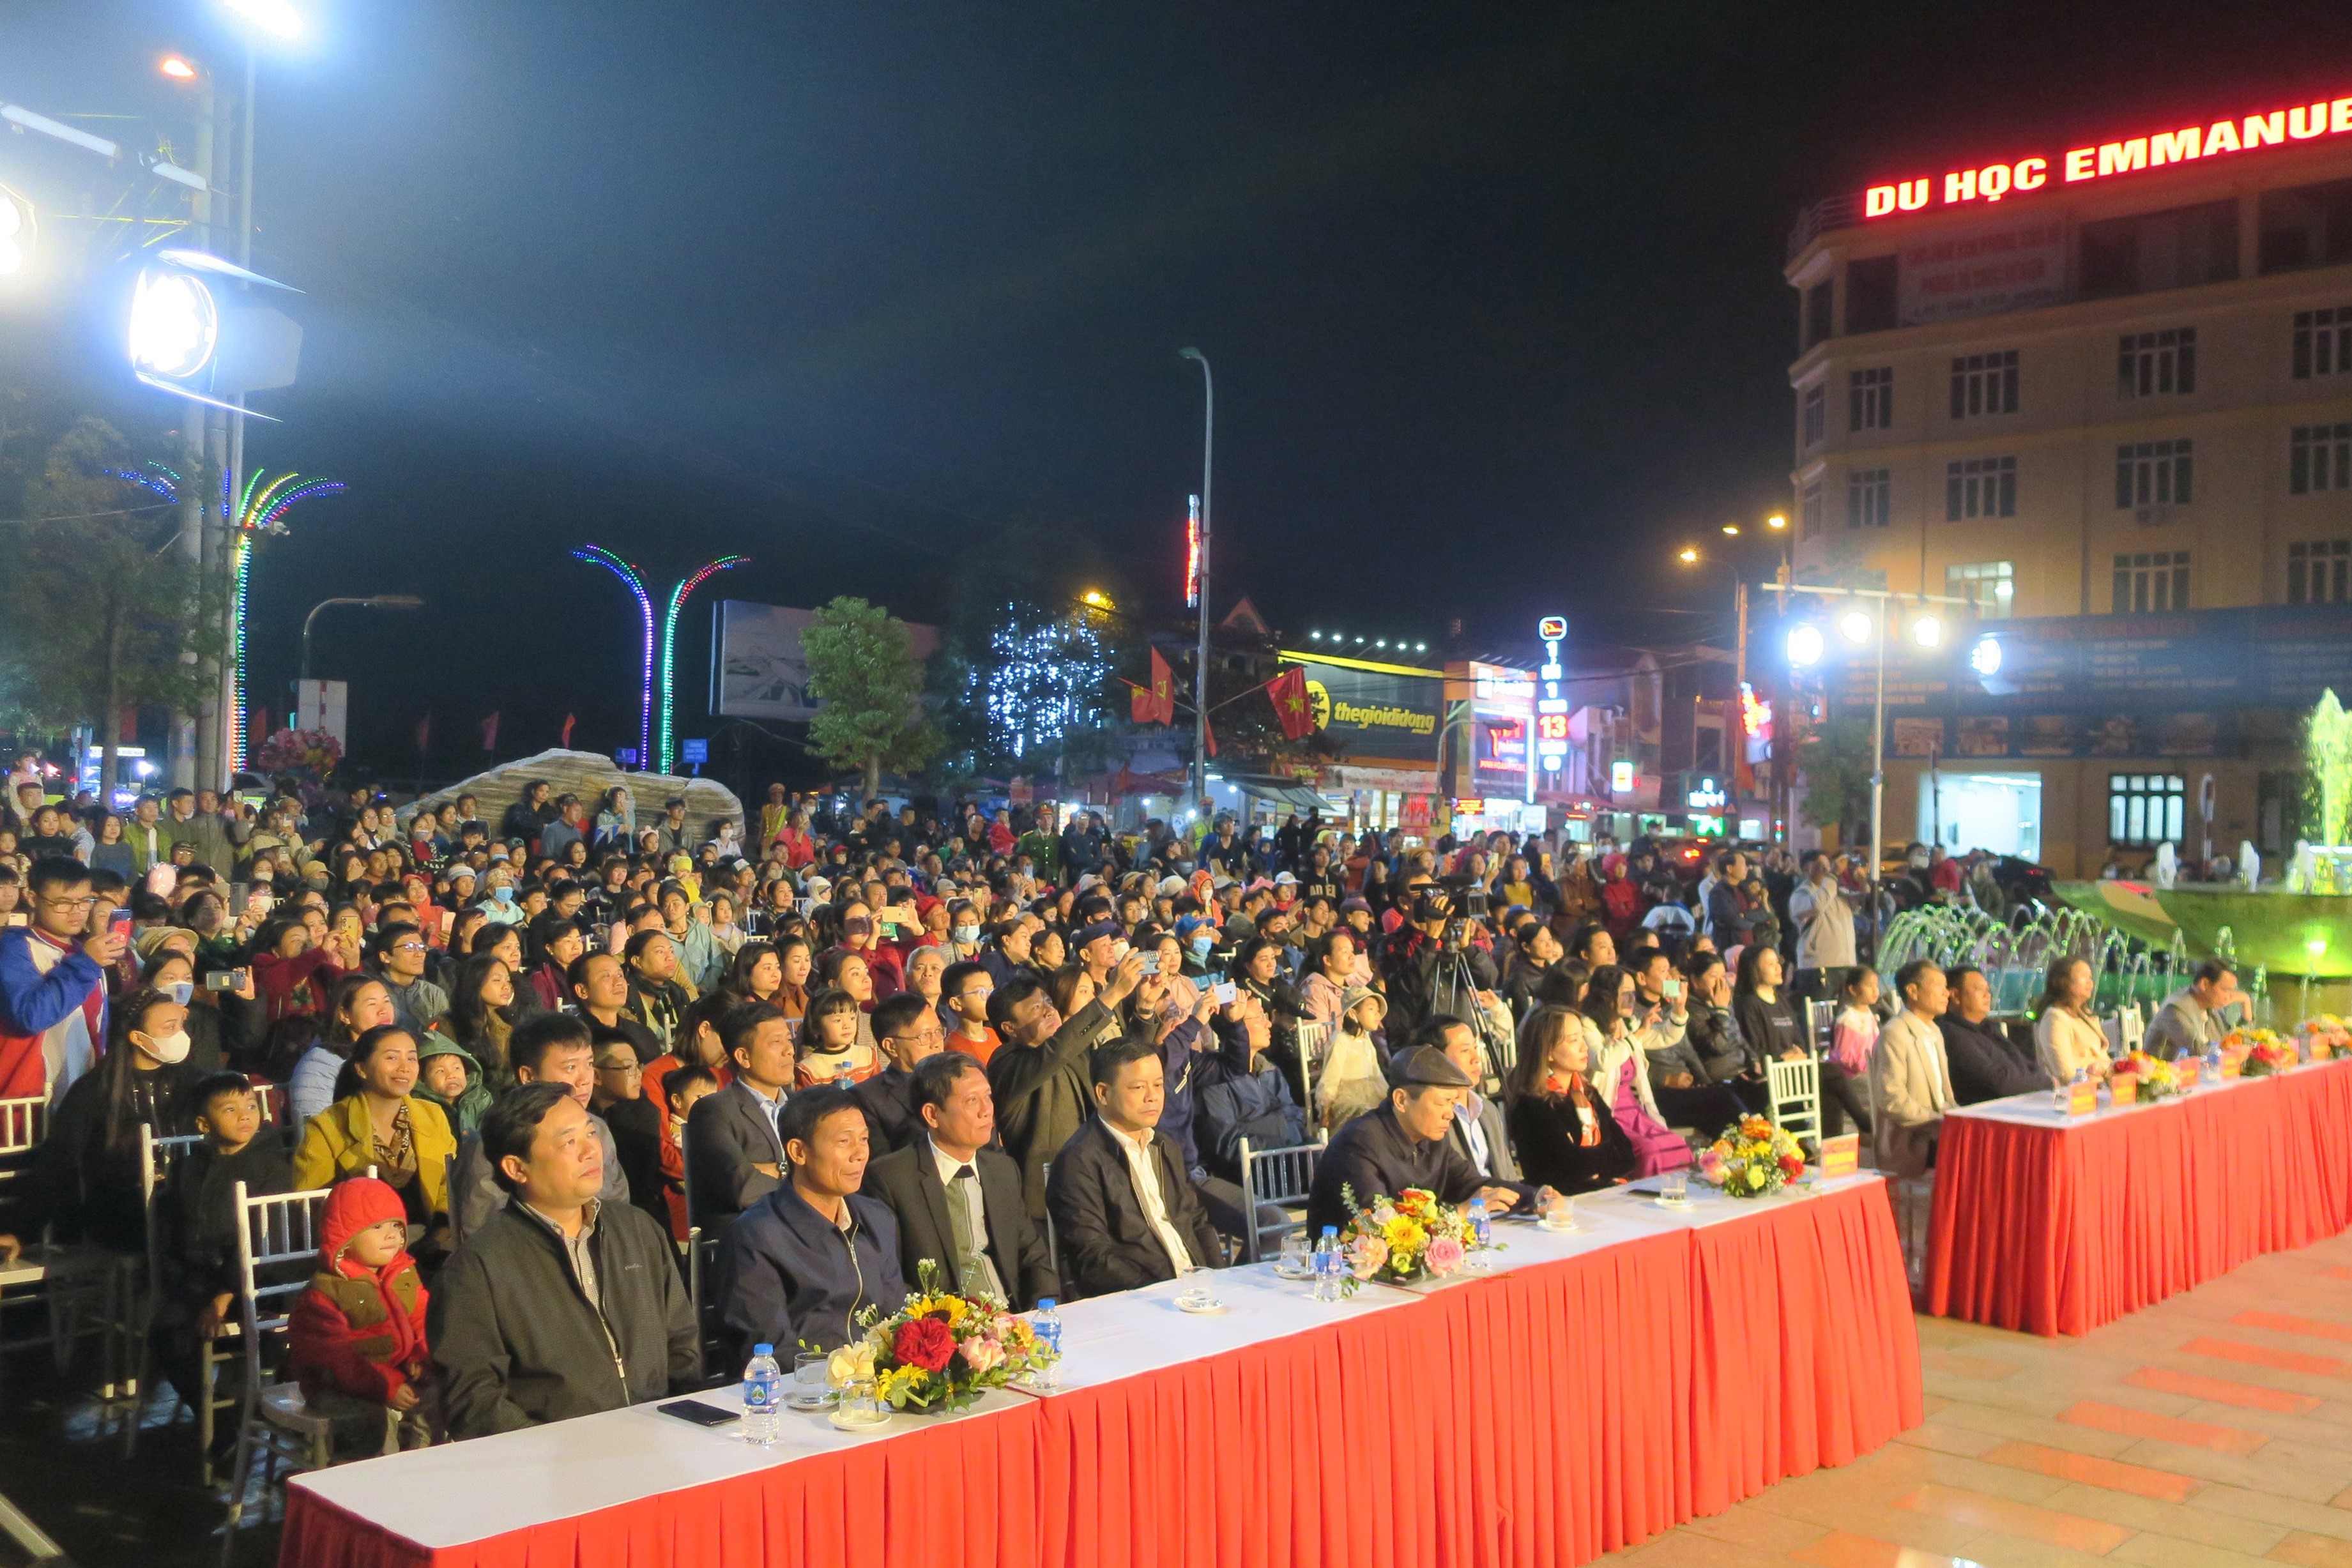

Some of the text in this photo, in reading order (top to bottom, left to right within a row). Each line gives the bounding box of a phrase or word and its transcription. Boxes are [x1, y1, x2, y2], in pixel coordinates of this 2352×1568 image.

[1865, 97, 2352, 218] DU HỌC EMMANUE
[1334, 701, 1436, 735] thegioididong
[1539, 714, 1567, 739] 13
